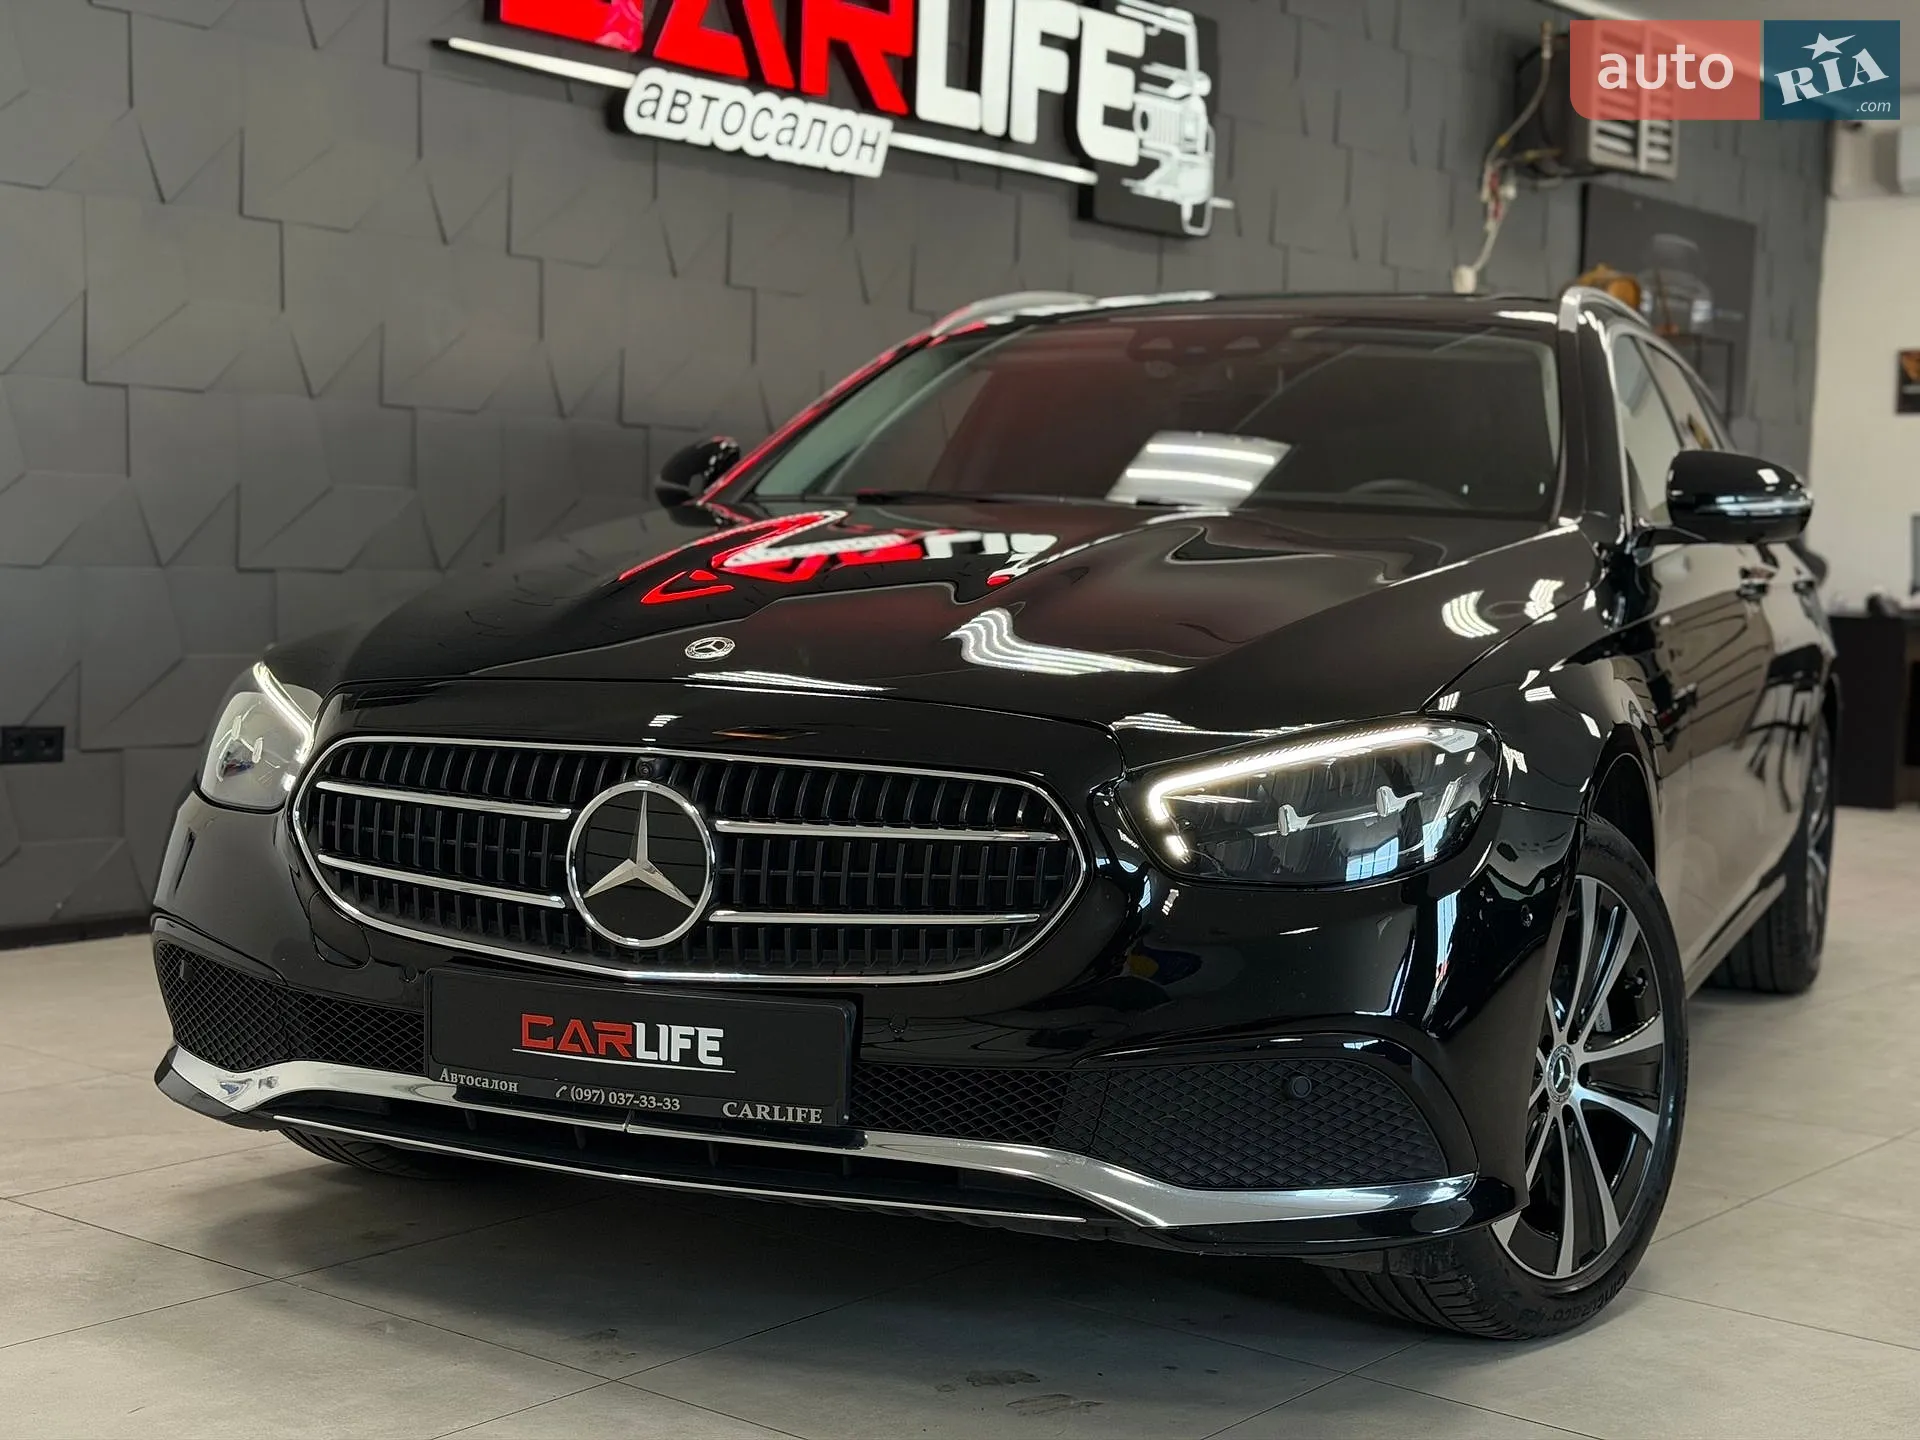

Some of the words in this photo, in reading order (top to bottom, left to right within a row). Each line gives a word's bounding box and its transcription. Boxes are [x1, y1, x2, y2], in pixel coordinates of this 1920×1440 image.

[635, 81, 882, 164] автосалон
[521, 1013, 723, 1066] CARLIFE
[439, 1068, 519, 1093] Автосалон
[570, 1086, 605, 1104] (097)
[608, 1091, 681, 1111] 037-33-33
[722, 1101, 823, 1124] CARLIFE
